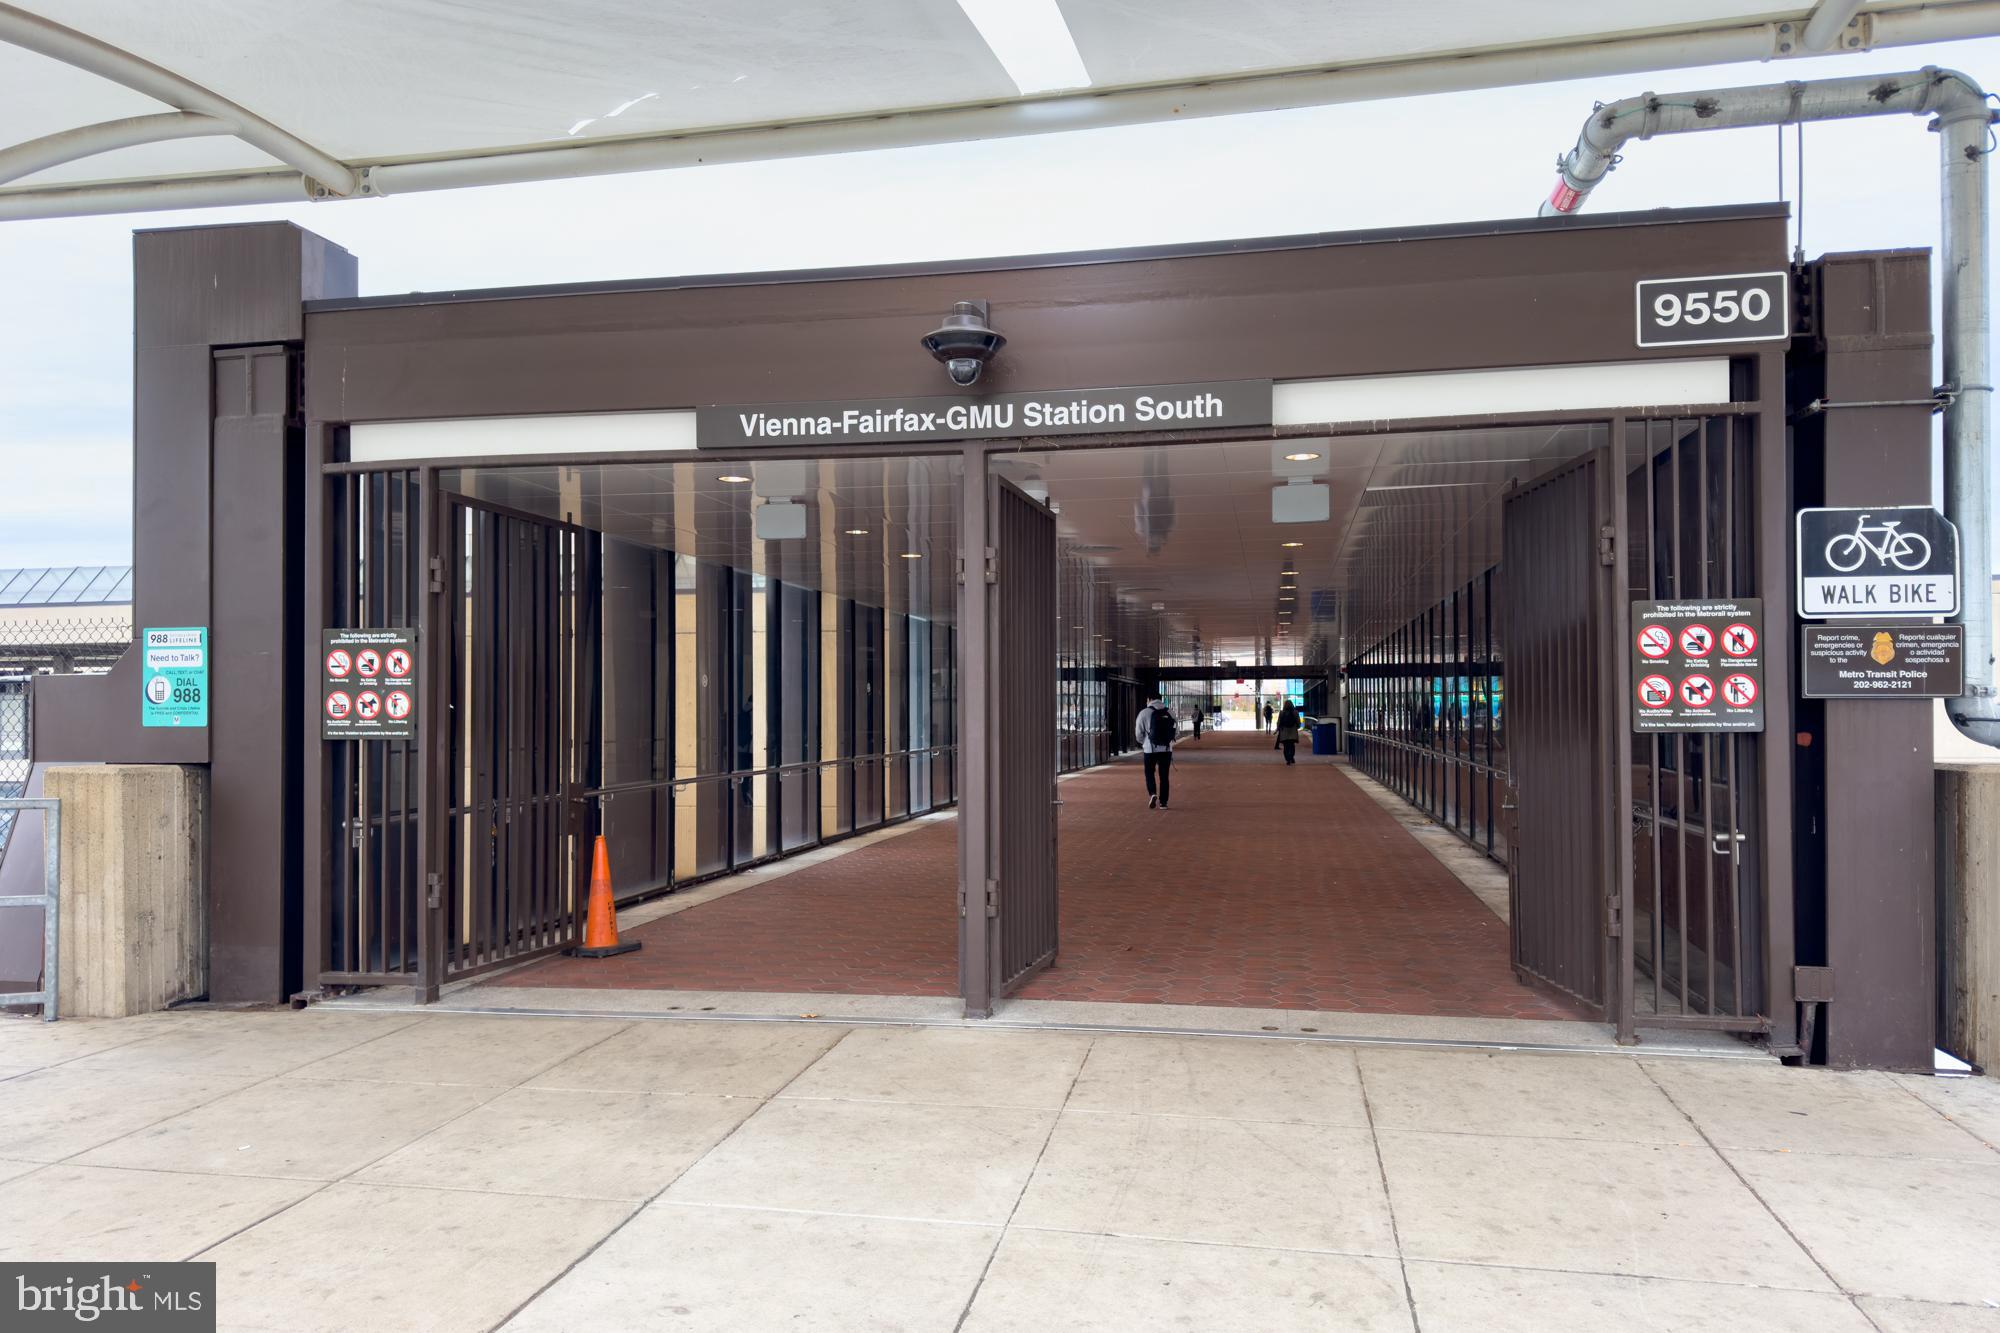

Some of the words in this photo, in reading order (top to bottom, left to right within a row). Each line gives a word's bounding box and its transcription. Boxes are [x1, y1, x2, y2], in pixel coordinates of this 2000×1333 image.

[1654, 288, 1770, 327] 9550
[739, 404, 1013, 437] Vienna-Fairfax-GMU
[1023, 400, 1125, 427] Station
[1135, 393, 1223, 421] South
[1822, 584, 1877, 604] WALK
[1889, 583, 1937, 603] BIKE
[1670, 605, 1700, 613] following
[150, 634, 168, 643] 988
[1817, 634, 1840, 642] Report
[180, 653, 200, 662] Talk?
[1839, 670, 1865, 678] Metro
[1866, 670, 1897, 678] Transit
[1900, 670, 1928, 678] Police
[176, 678, 198, 686] DIAL
[1853, 681, 1912, 689] 202-962-2121
[174, 688, 201, 703] 988
